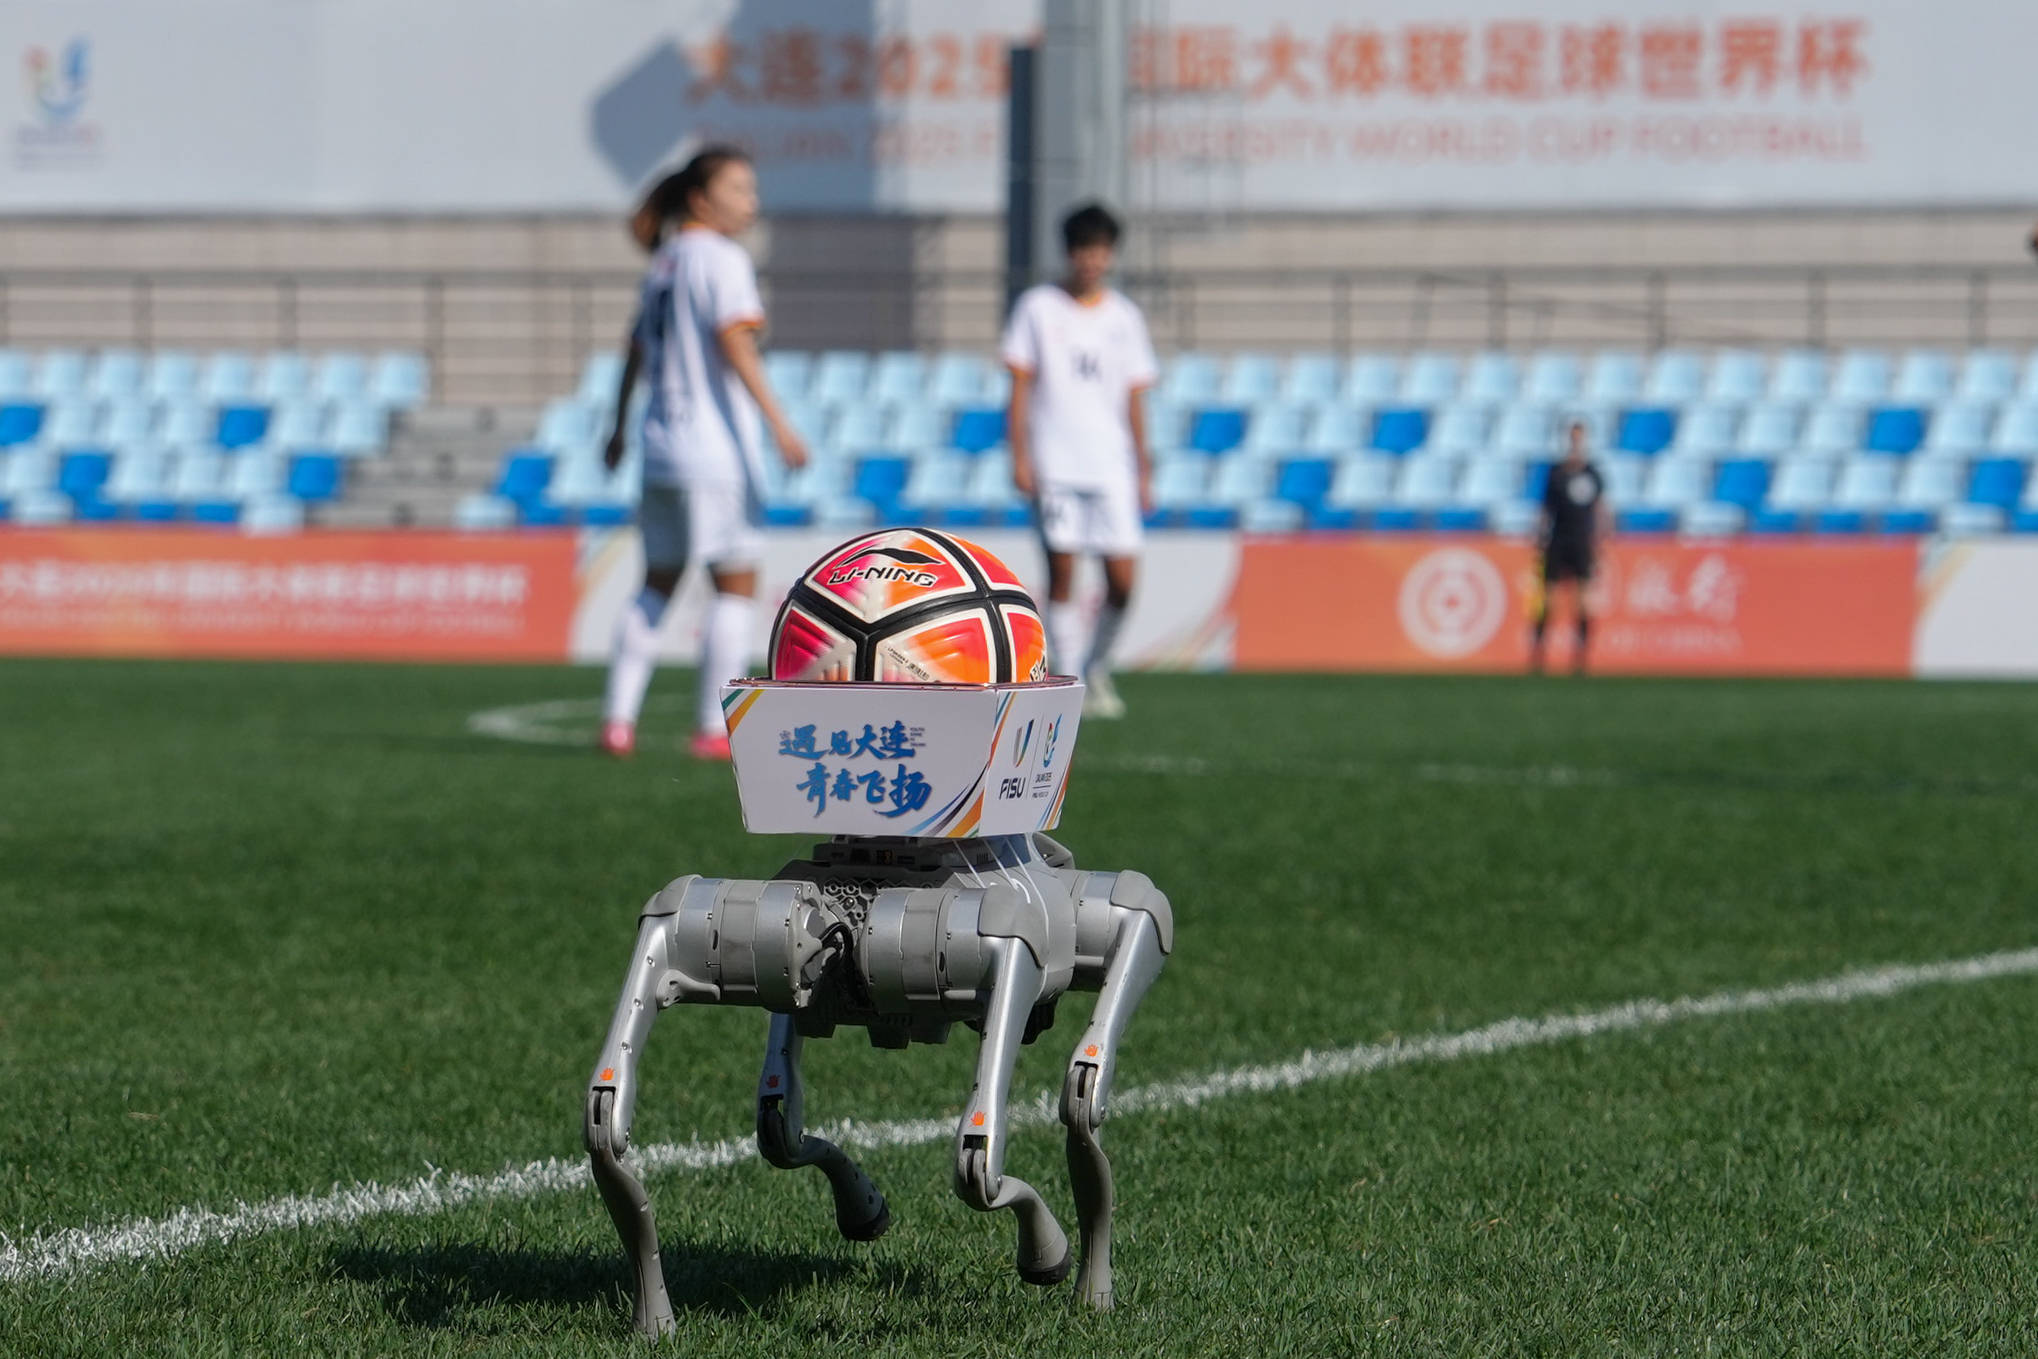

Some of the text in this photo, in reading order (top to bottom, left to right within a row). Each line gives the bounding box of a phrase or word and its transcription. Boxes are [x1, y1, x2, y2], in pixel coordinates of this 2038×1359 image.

[828, 567, 937, 586] LI-NING
[778, 720, 916, 760] 遇见大连
[796, 762, 932, 818] 青春飞扬
[999, 777, 1026, 800] FISU
